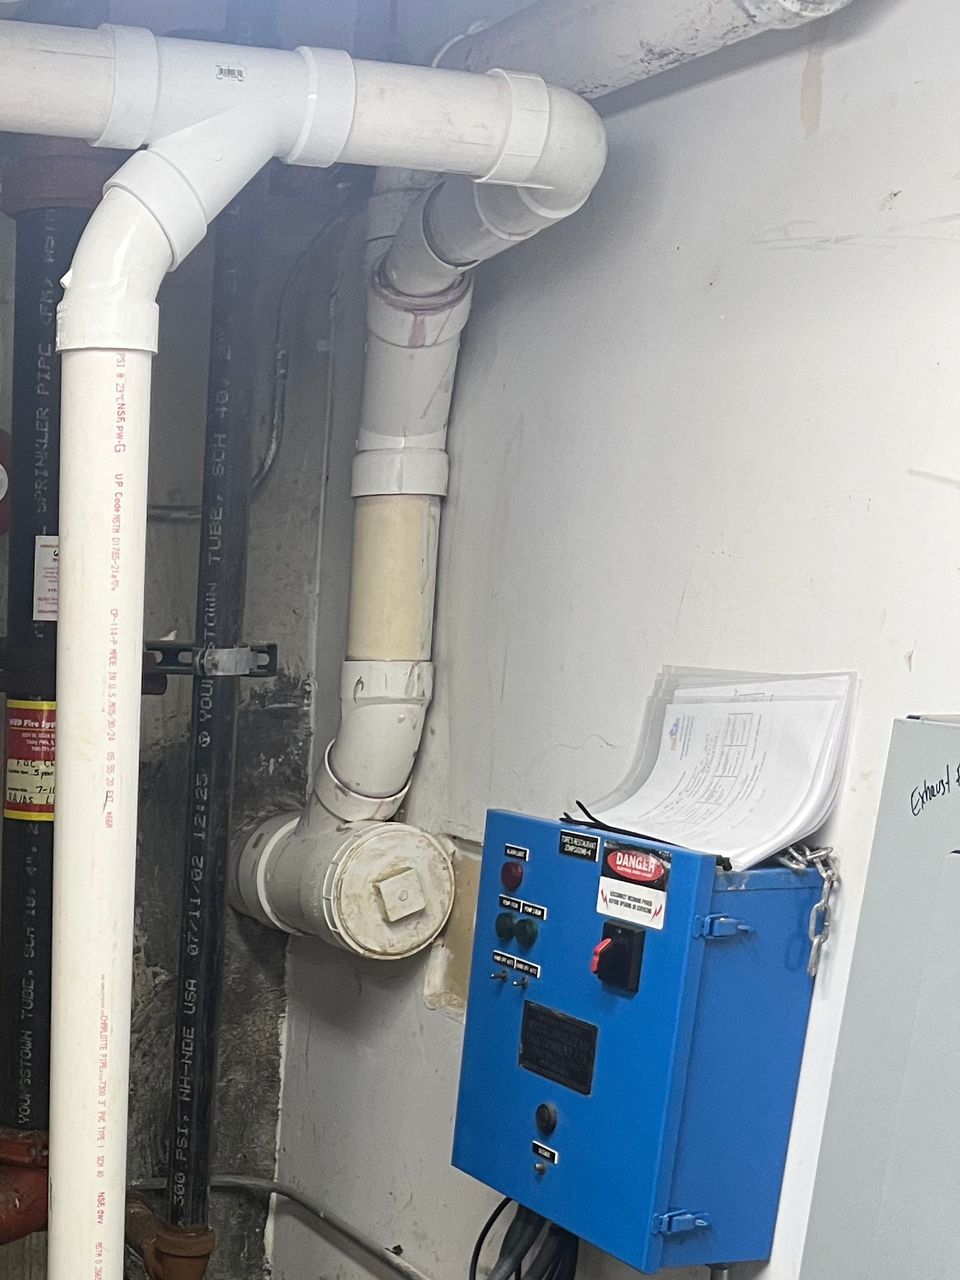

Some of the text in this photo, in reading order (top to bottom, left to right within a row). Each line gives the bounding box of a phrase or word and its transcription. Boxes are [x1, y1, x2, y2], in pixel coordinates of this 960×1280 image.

[34, 407, 49, 513] SPRINKLER
[213, 433, 226, 476] SCH
[23, 719, 39, 728] Fire
[187, 773, 208, 956] 07/11/02 12:25
[616, 852, 657, 873] DANGER
[173, 1172, 185, 1206] 300
[184, 979, 198, 1015] USA
